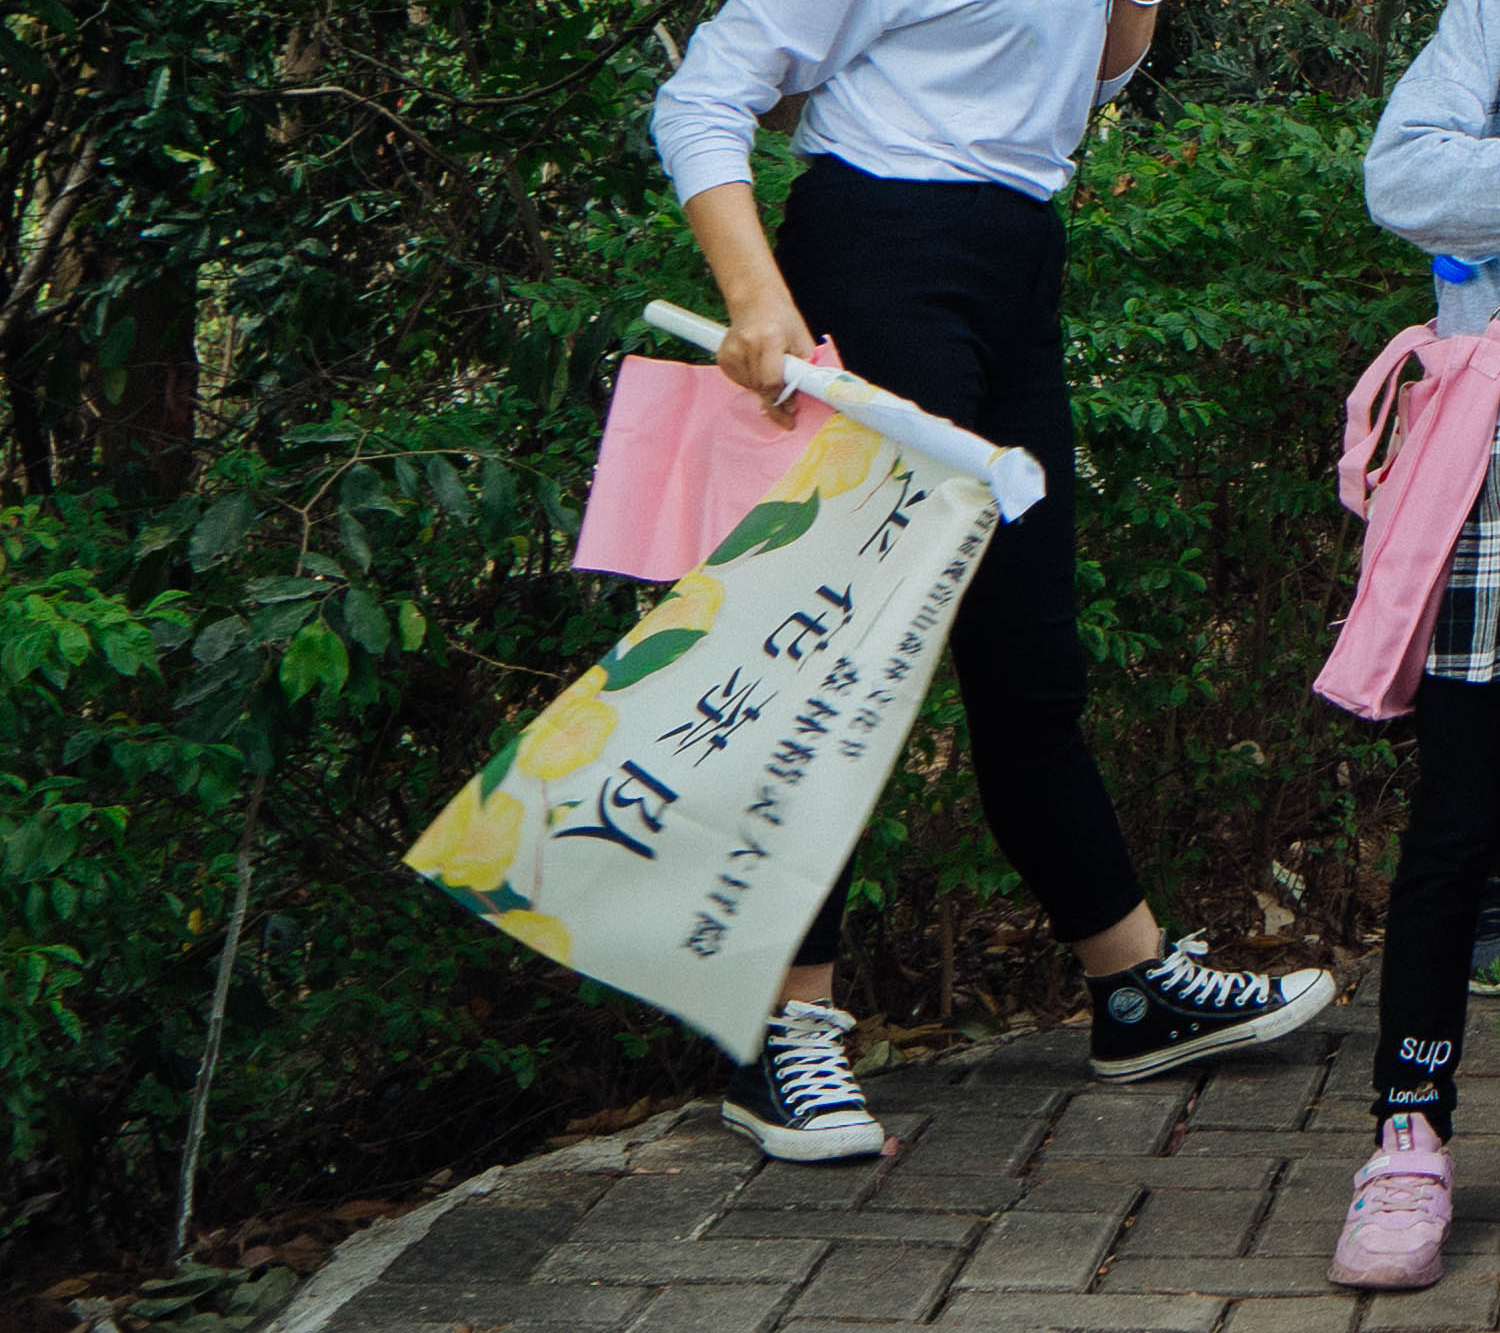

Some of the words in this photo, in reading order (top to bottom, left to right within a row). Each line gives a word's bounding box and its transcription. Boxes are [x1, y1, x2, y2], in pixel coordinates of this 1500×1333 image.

[839, 498, 1001, 763] 首届观音山森林文化节
